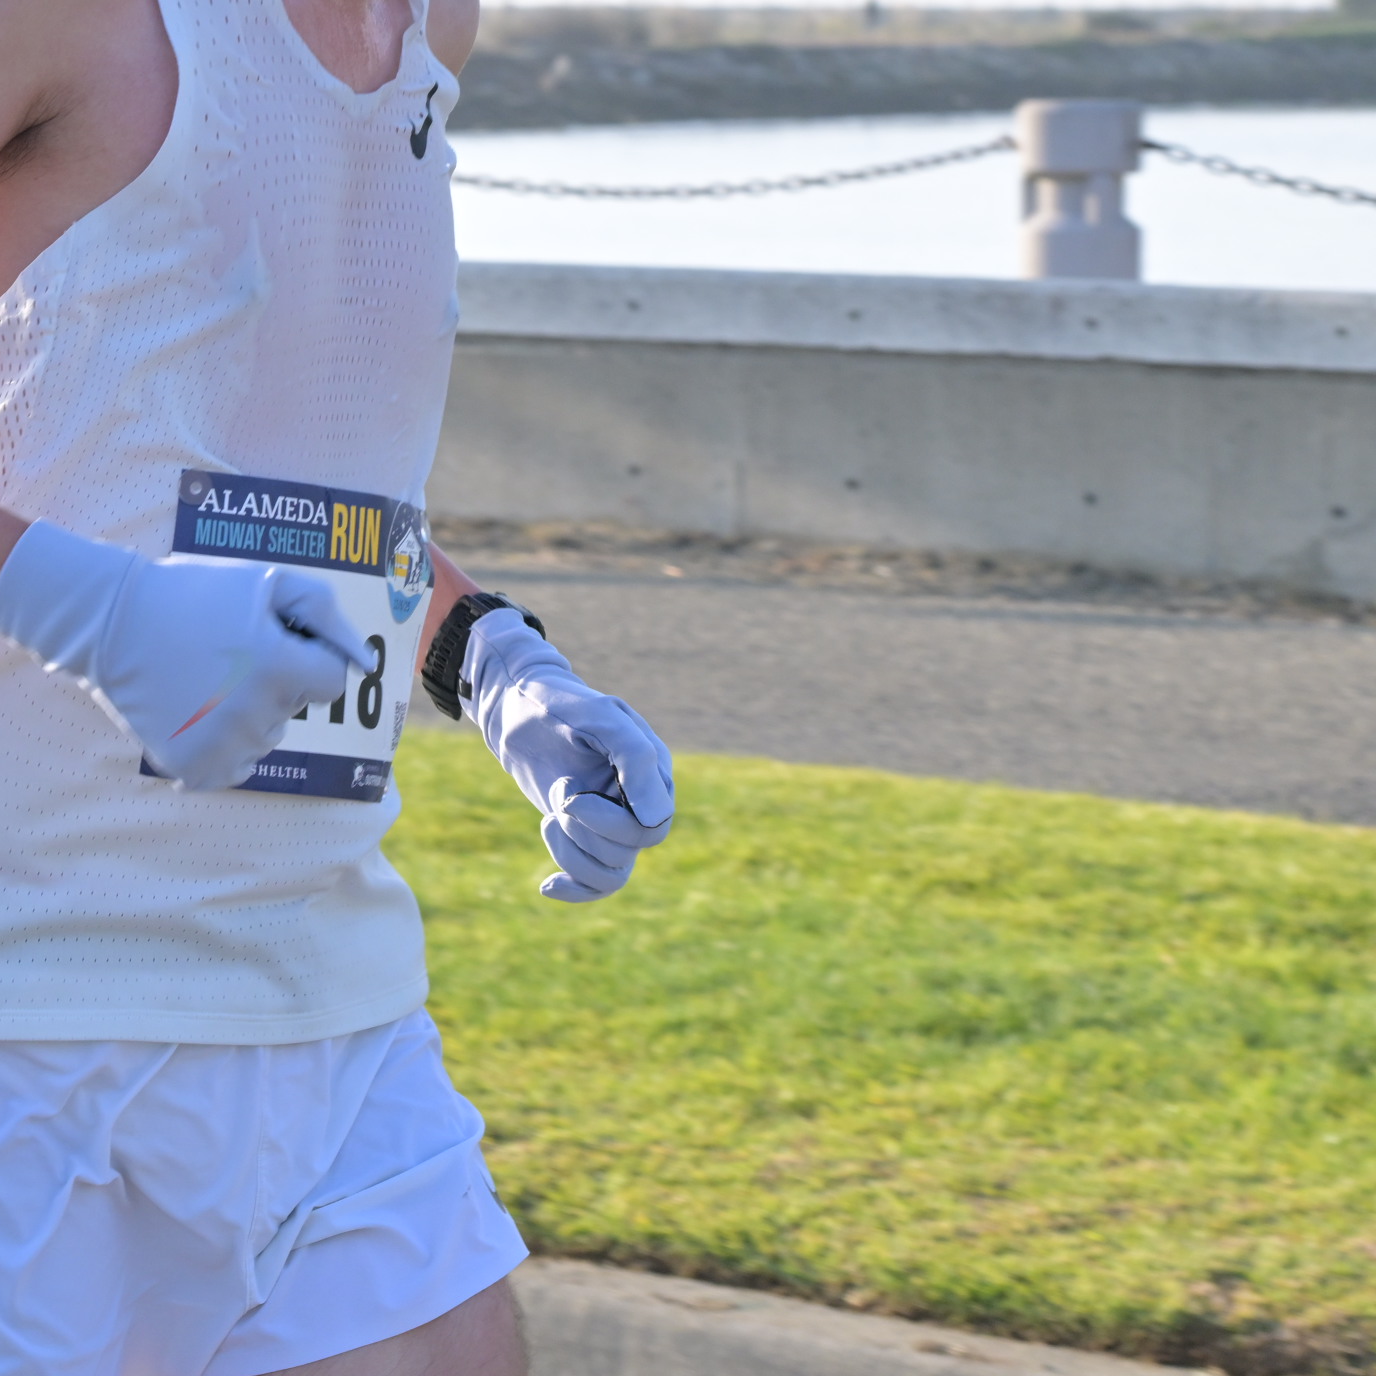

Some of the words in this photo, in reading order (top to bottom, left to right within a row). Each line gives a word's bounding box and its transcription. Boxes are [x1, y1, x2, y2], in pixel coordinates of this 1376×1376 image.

[197, 488, 328, 526] ALAMEDA
[194, 518, 266, 551] MIDWAY
[268, 526, 326, 559] SHELTER
[330, 502, 381, 566] RUN
